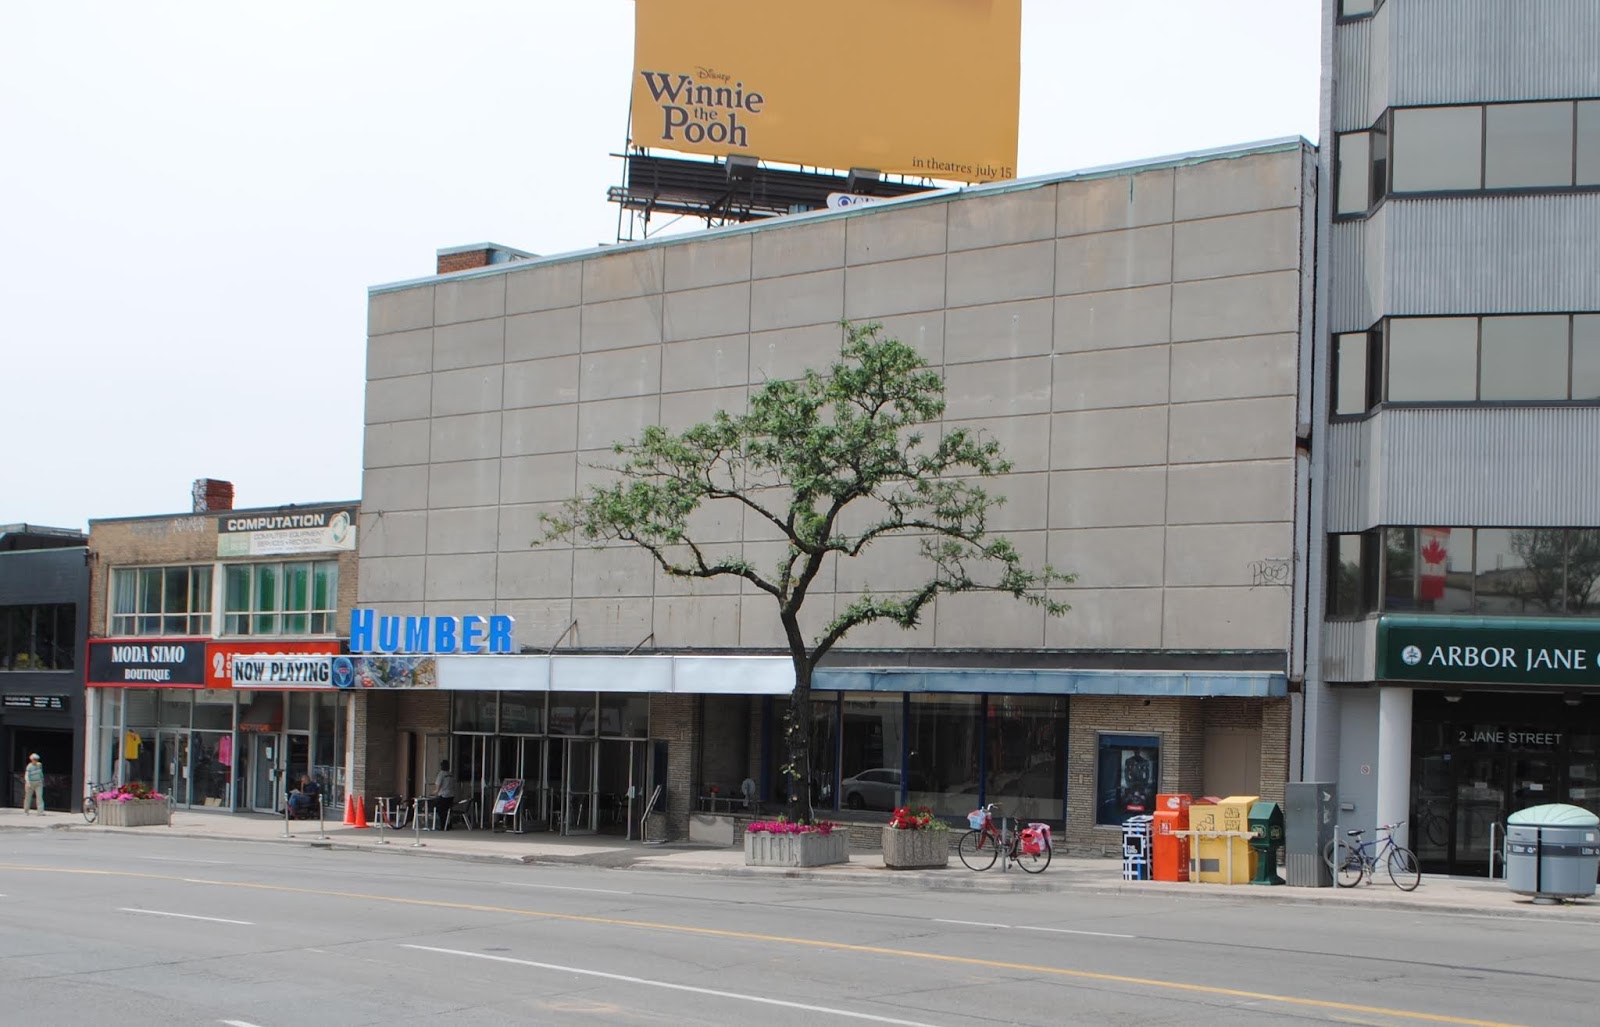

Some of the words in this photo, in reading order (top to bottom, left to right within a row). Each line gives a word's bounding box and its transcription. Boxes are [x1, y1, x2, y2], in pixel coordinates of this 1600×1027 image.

[640, 71, 764, 113] Winnie
[694, 107, 718, 121] the
[661, 105, 748, 147] Pooh
[912, 156, 924, 168] in
[926, 157, 972, 174] theatres
[975, 164, 998, 179] july
[1000, 167, 1012, 178] 15
[227, 513, 325, 531] COMPUTATION
[349, 608, 513, 654] HUMBER
[111, 646, 149, 663] MODA
[151, 645, 186, 663] SIMO
[1428, 645, 1517, 668] ARBOR
[1526, 648, 1587, 671] JANE
[124, 668, 170, 682] BOUTIQUE
[213, 652, 225, 678] 2
[235, 662, 264, 681] NOW
[269, 662, 329, 682] PLAYING
[1459, 731, 1467, 742] 2
[1470, 731, 1505, 743] JANE
[1508, 732, 1563, 745] STREET
